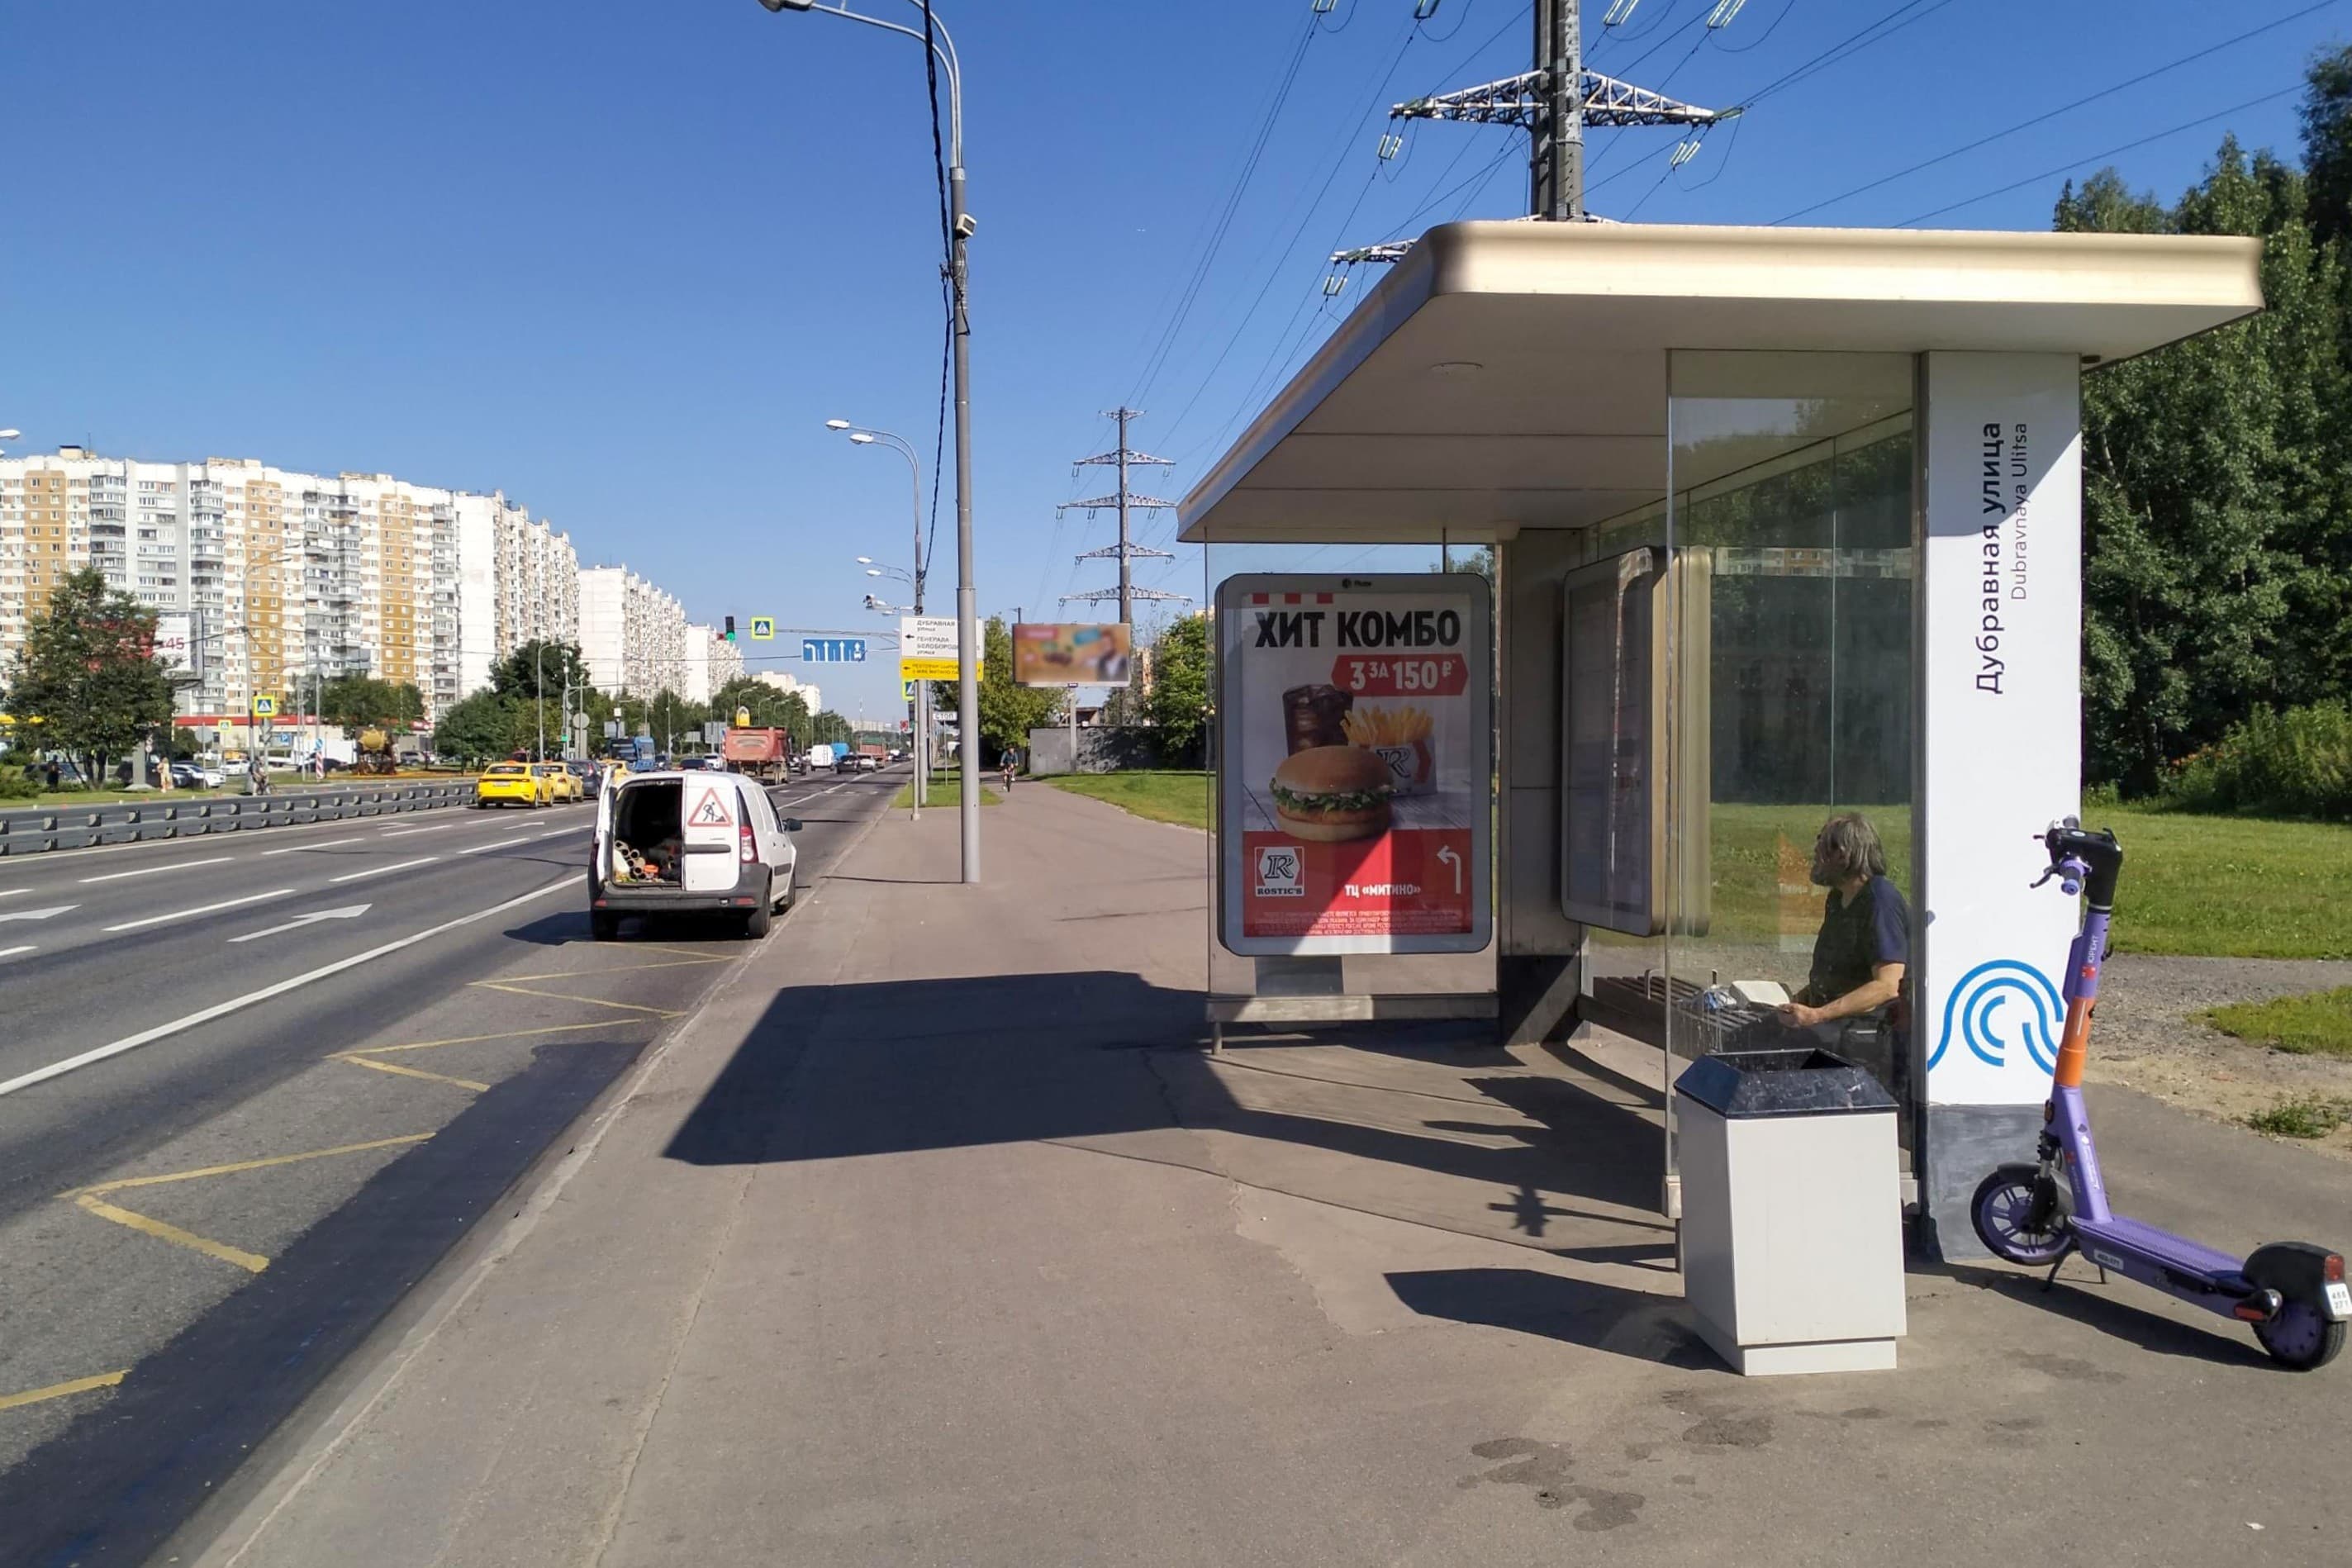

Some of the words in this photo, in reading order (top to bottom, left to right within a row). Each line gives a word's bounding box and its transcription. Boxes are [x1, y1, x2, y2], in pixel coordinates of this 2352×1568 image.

[1983, 422, 2006, 514] улица
[2011, 422, 2027, 477] Ulitsa
[2011, 483, 2030, 601] Dubravnaya
[1255, 611, 1325, 648] ХИТ
[1338, 610, 1461, 648] КОМБО
[1975, 525, 2004, 694] Дубравная
[1350, 661, 1366, 690] 3
[1393, 661, 1438, 690] 150
[1344, 884, 1359, 898] ТЦ
[1361, 883, 1421, 896] «МИТИНО»
